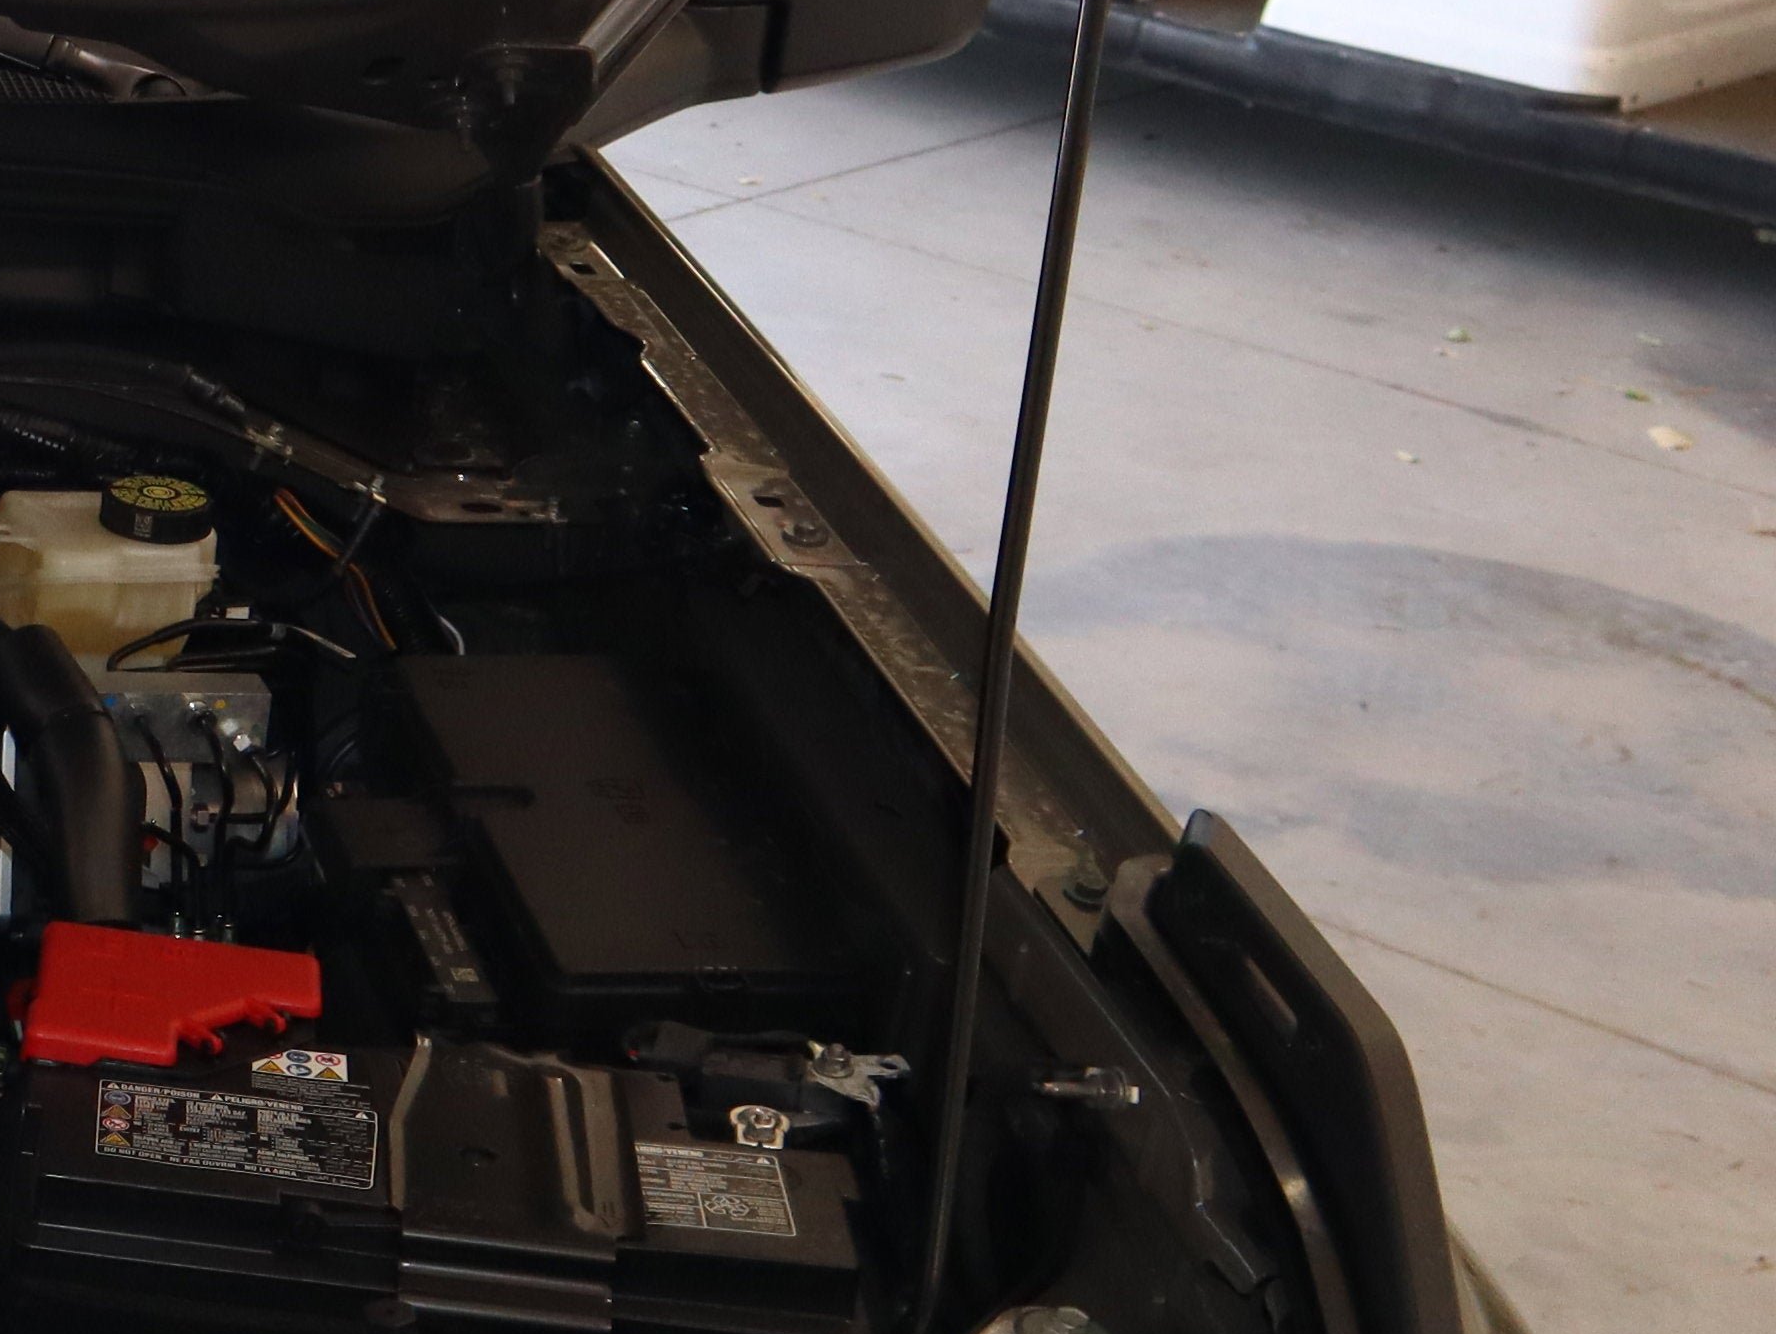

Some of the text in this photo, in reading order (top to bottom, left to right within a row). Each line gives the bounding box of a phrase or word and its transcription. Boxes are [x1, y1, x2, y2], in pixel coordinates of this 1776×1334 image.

[121, 1083, 200, 1099] DANGER/POISON
[118, 1148, 136, 1156] NOT
[138, 1151, 162, 1160] OPEN
